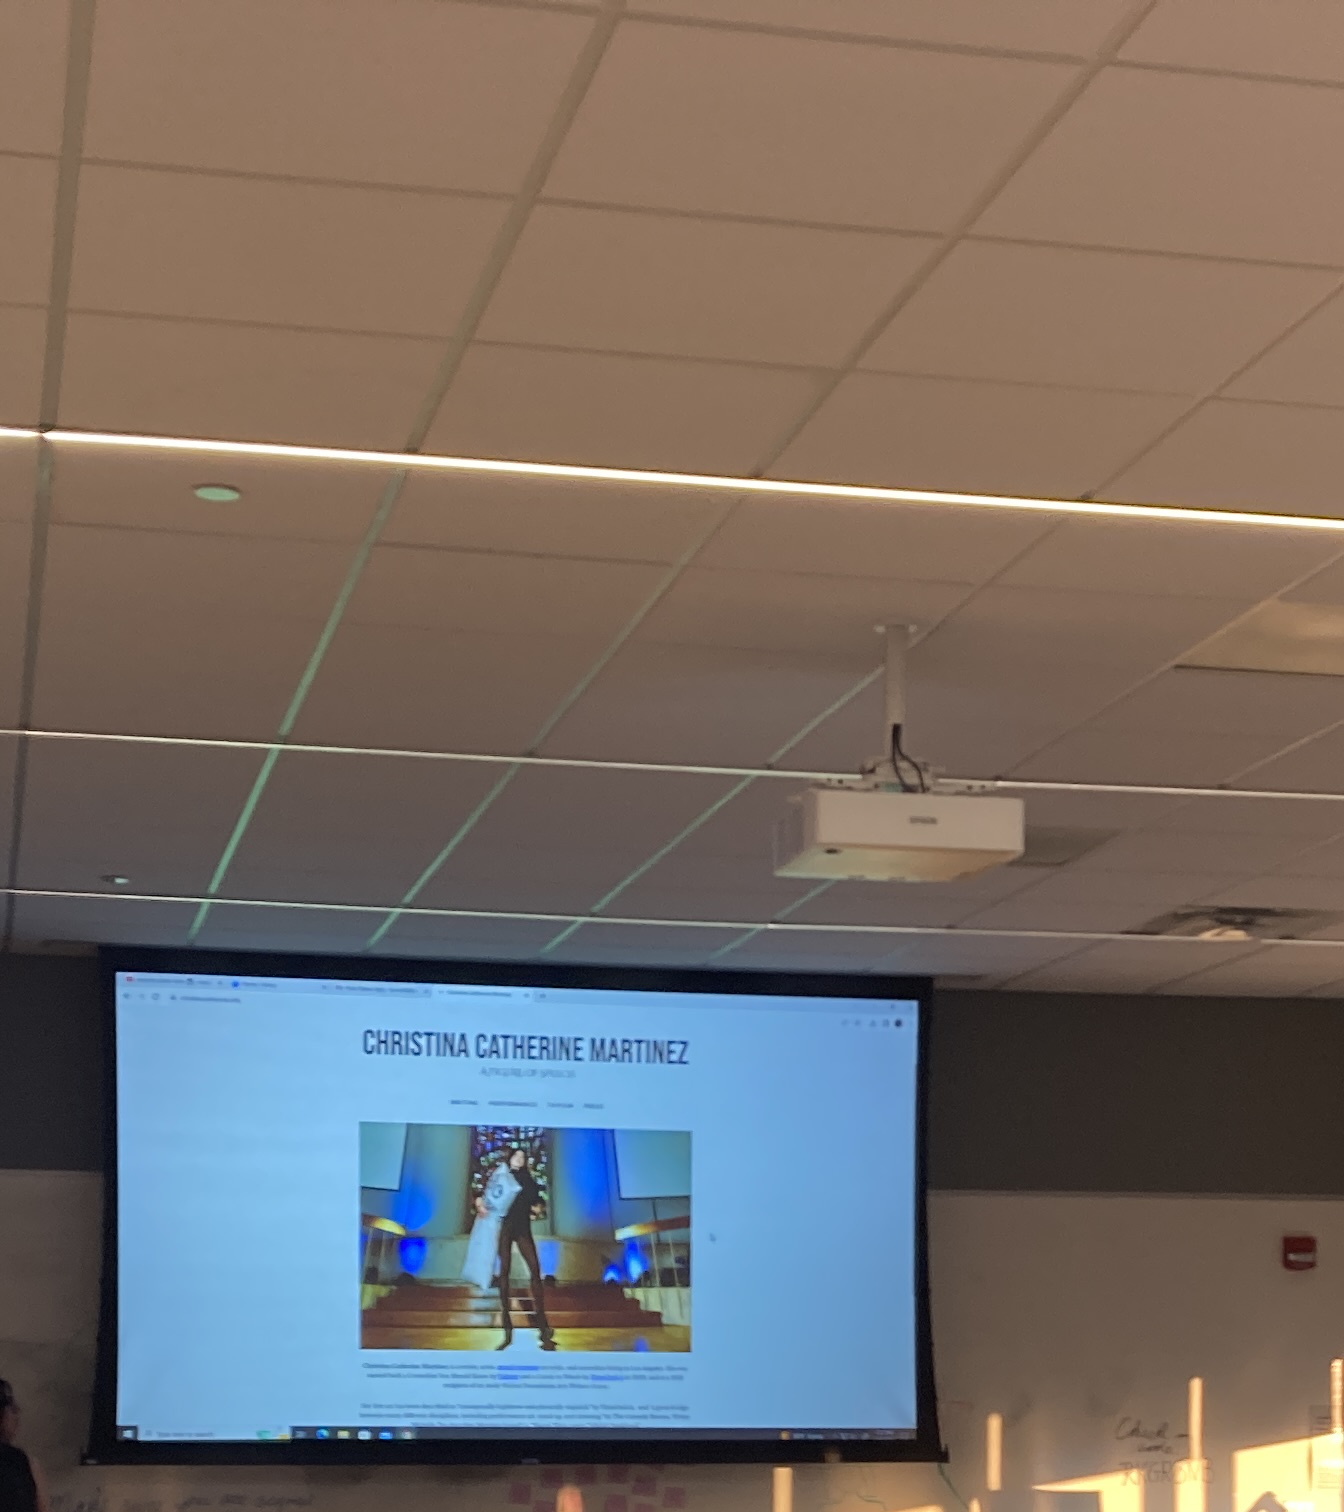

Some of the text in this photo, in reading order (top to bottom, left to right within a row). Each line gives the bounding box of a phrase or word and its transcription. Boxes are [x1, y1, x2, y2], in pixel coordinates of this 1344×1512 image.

[363, 1029, 689, 1065] CHRISTINA CATHERINE MARTINEZ
